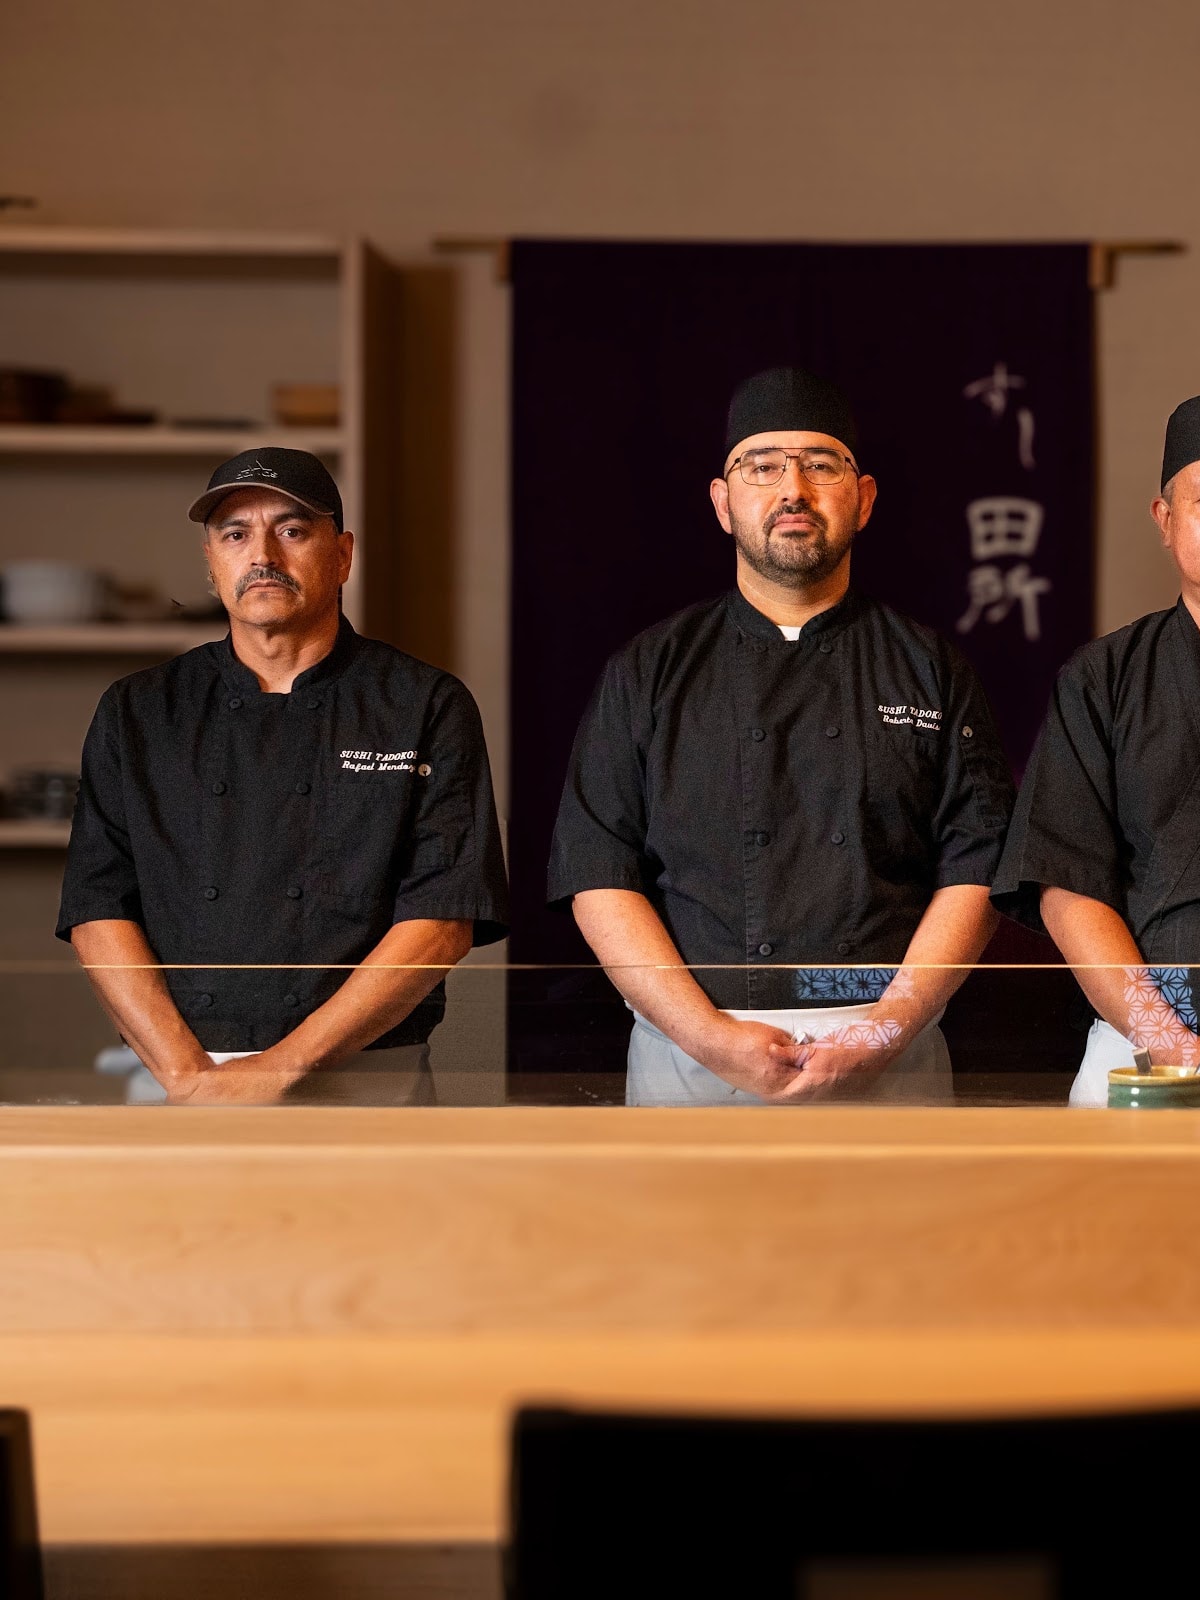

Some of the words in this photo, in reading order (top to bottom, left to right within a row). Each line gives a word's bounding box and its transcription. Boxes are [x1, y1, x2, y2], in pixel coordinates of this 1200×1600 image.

[878, 705, 907, 714] SUSHI
[340, 750, 372, 760] SUSHI
[342, 761, 374, 772] Rafael
